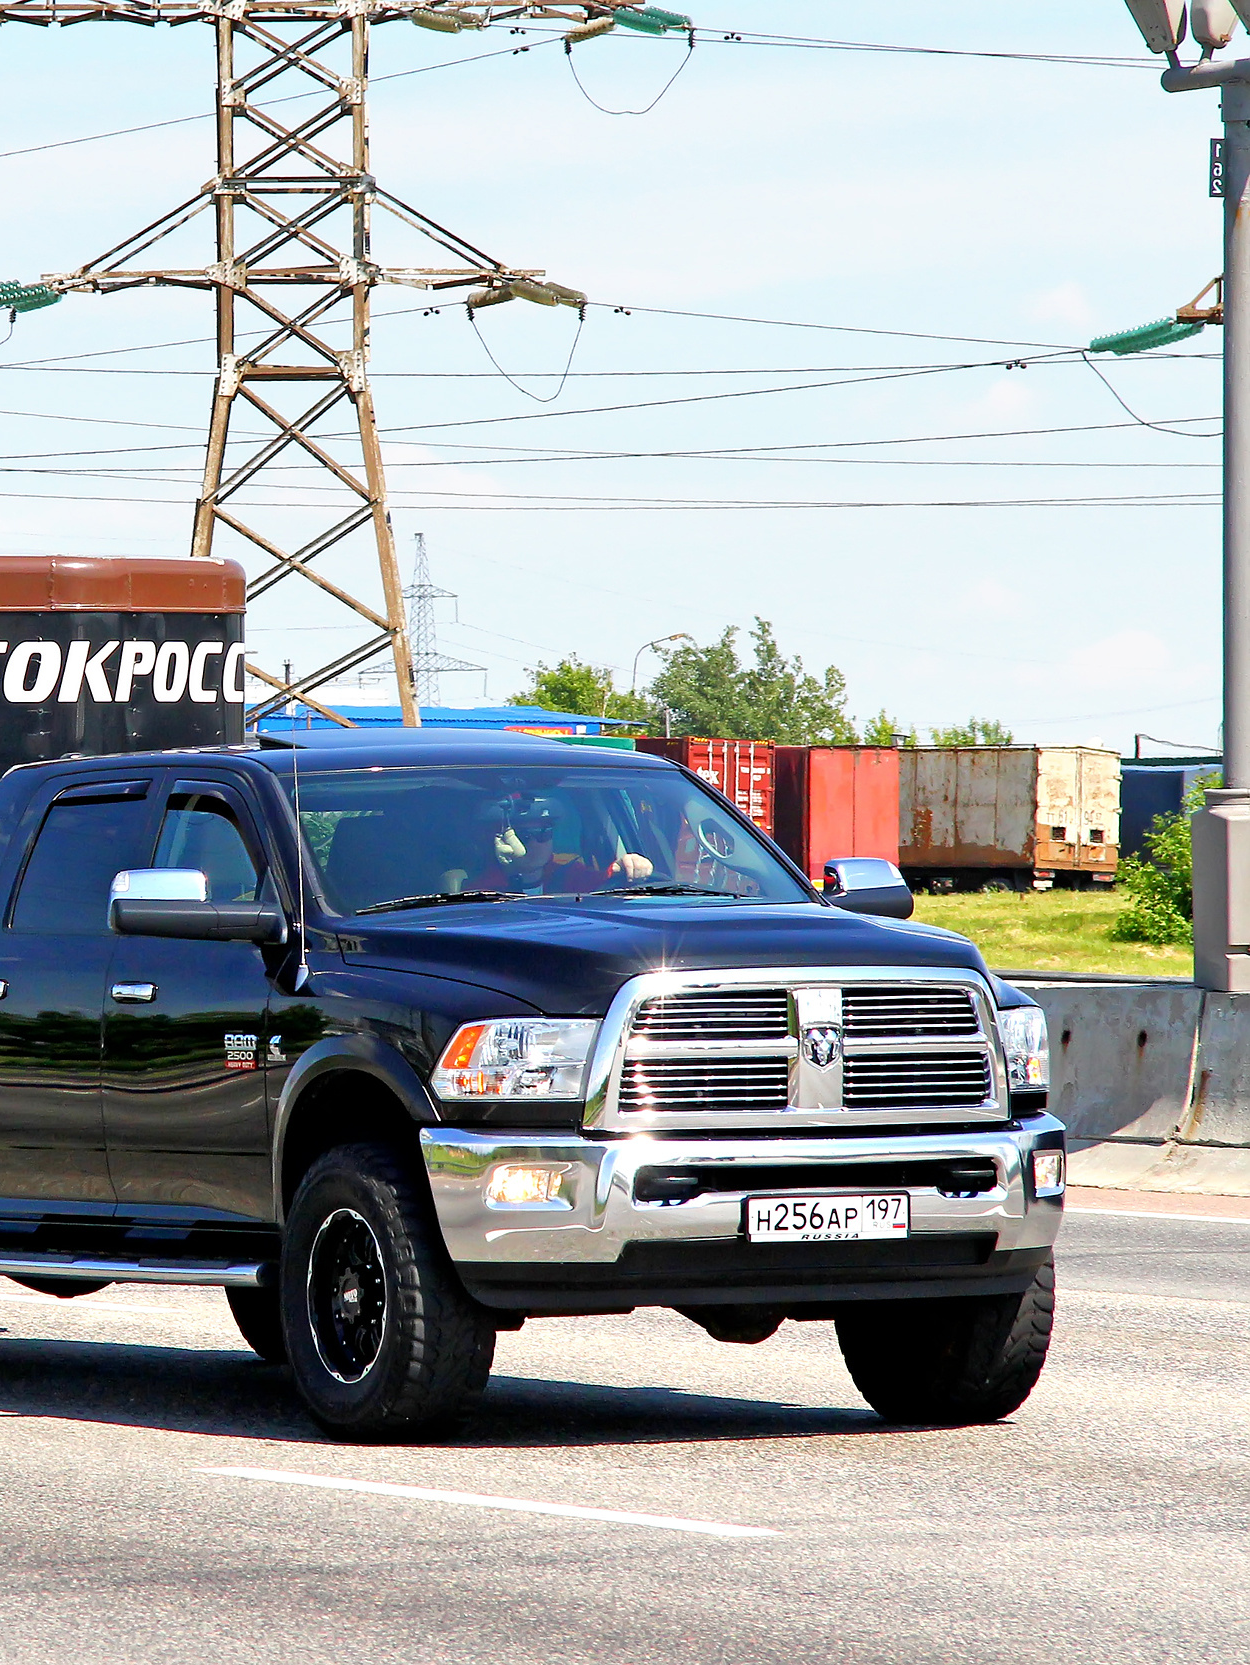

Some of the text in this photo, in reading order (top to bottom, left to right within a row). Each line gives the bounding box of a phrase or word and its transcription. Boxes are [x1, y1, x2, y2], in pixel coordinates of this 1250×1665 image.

[227, 1051, 253, 1060] 2500
[866, 1198, 902, 1220] 197
[873, 1221, 892, 1229] RUS
